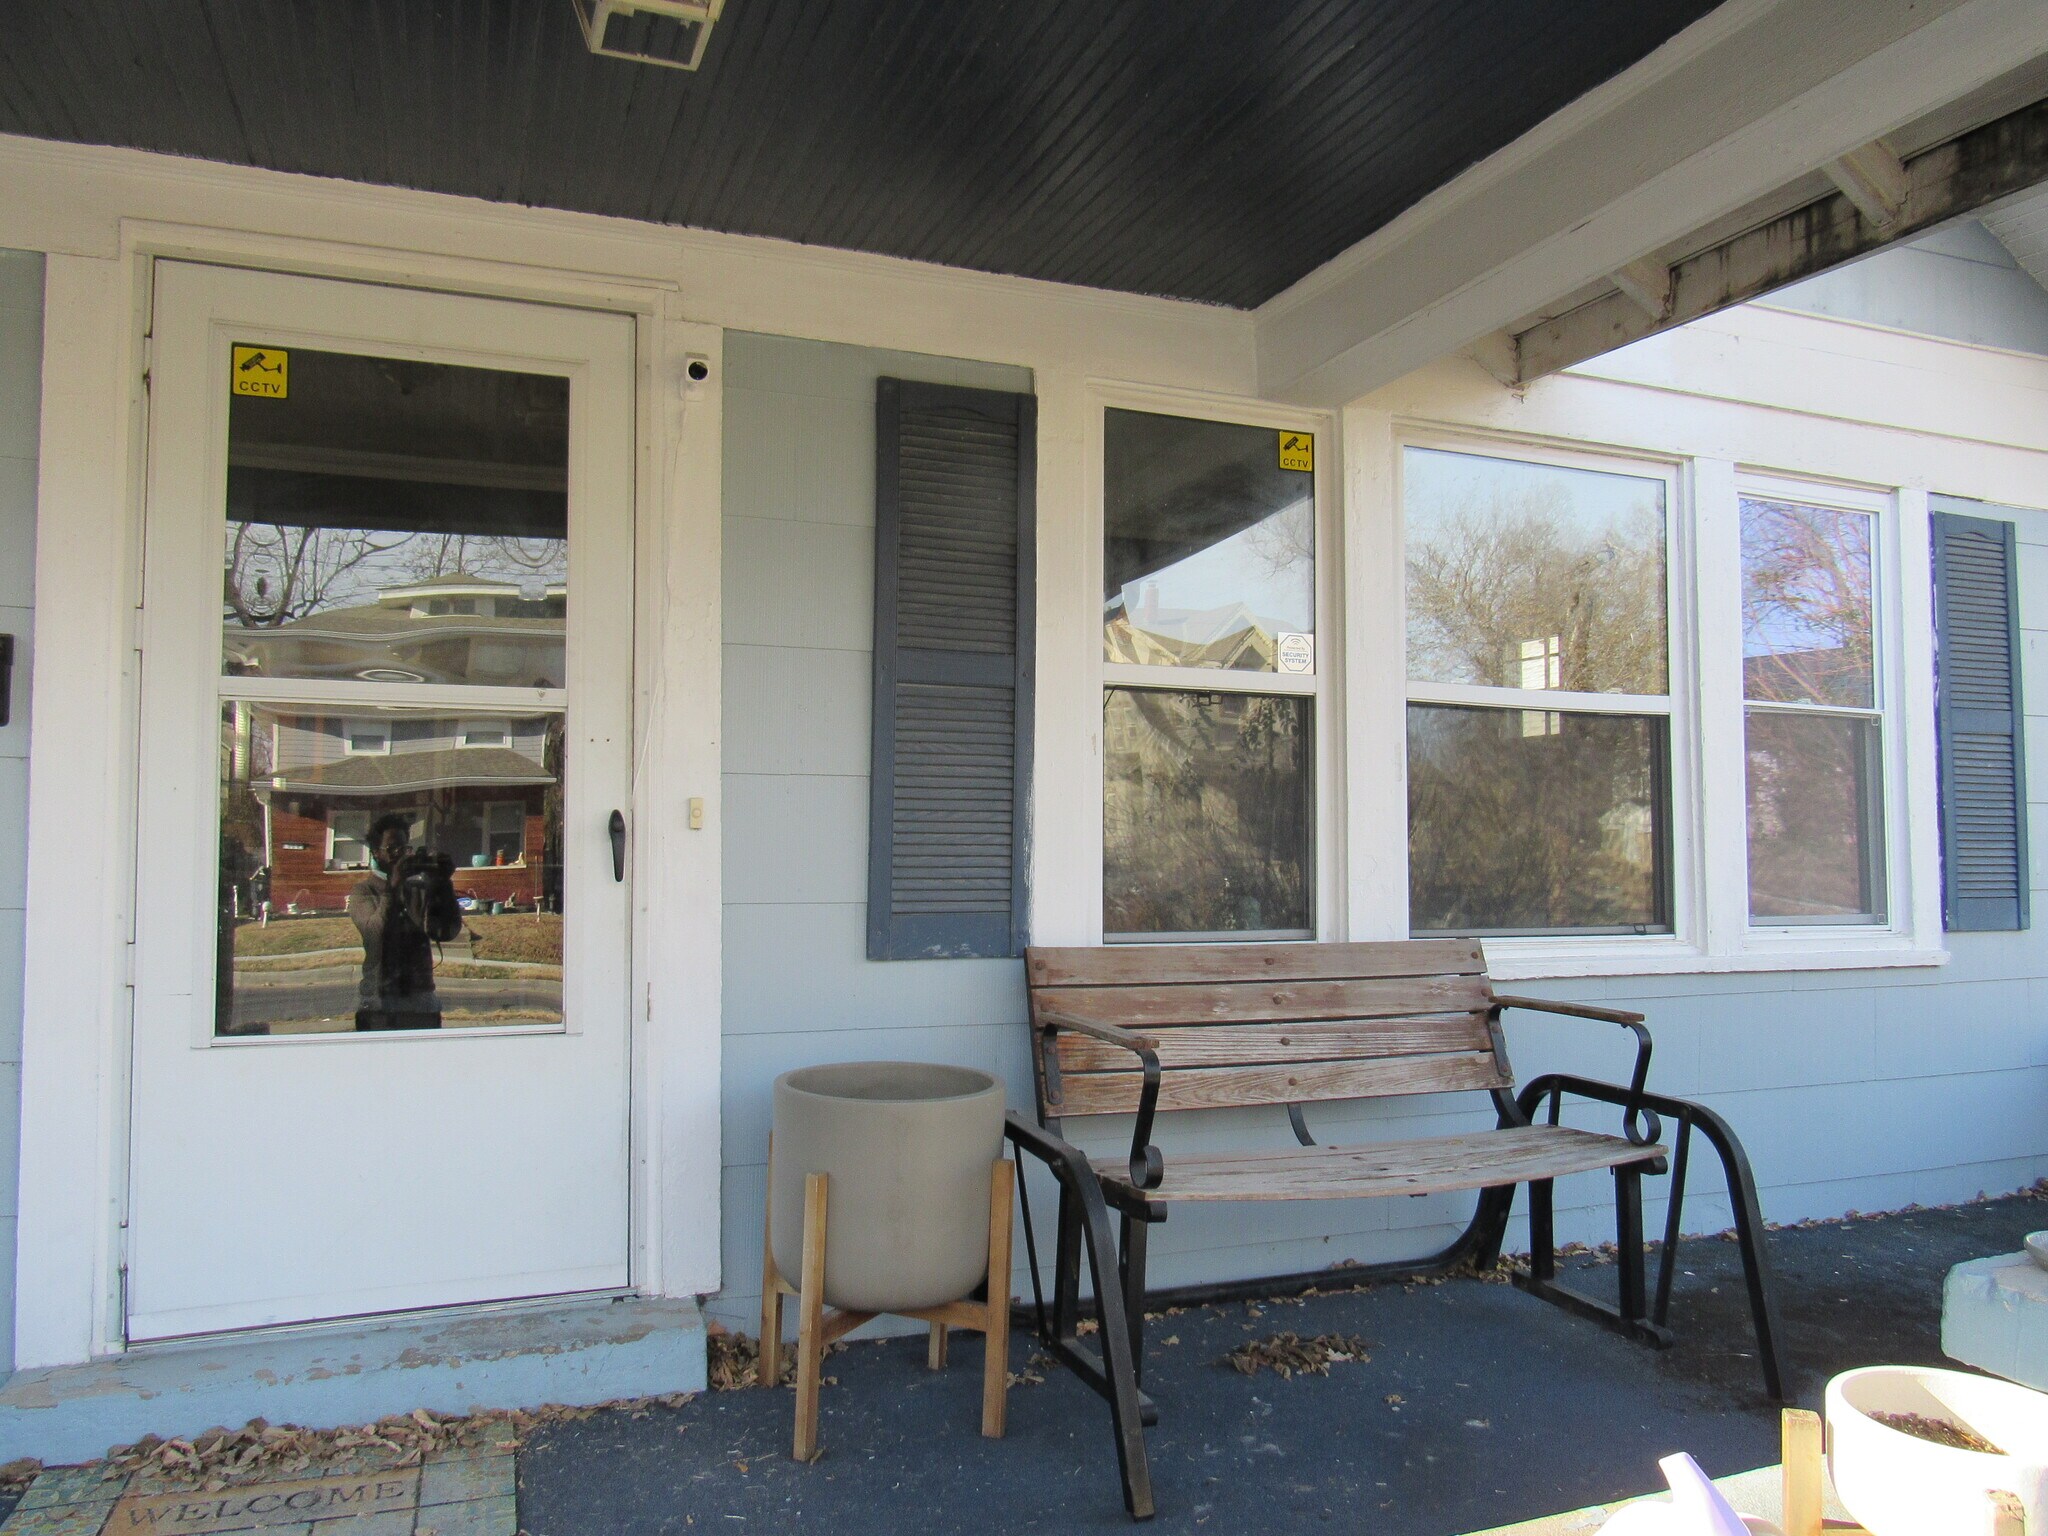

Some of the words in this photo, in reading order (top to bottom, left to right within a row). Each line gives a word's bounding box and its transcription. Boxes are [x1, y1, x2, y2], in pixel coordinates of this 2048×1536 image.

[239, 381, 280, 394] CCTV
[1283, 458, 1309, 468] CCTV
[1282, 651, 1310, 659] SECURITY
[128, 1480, 405, 1526] WELCOME
